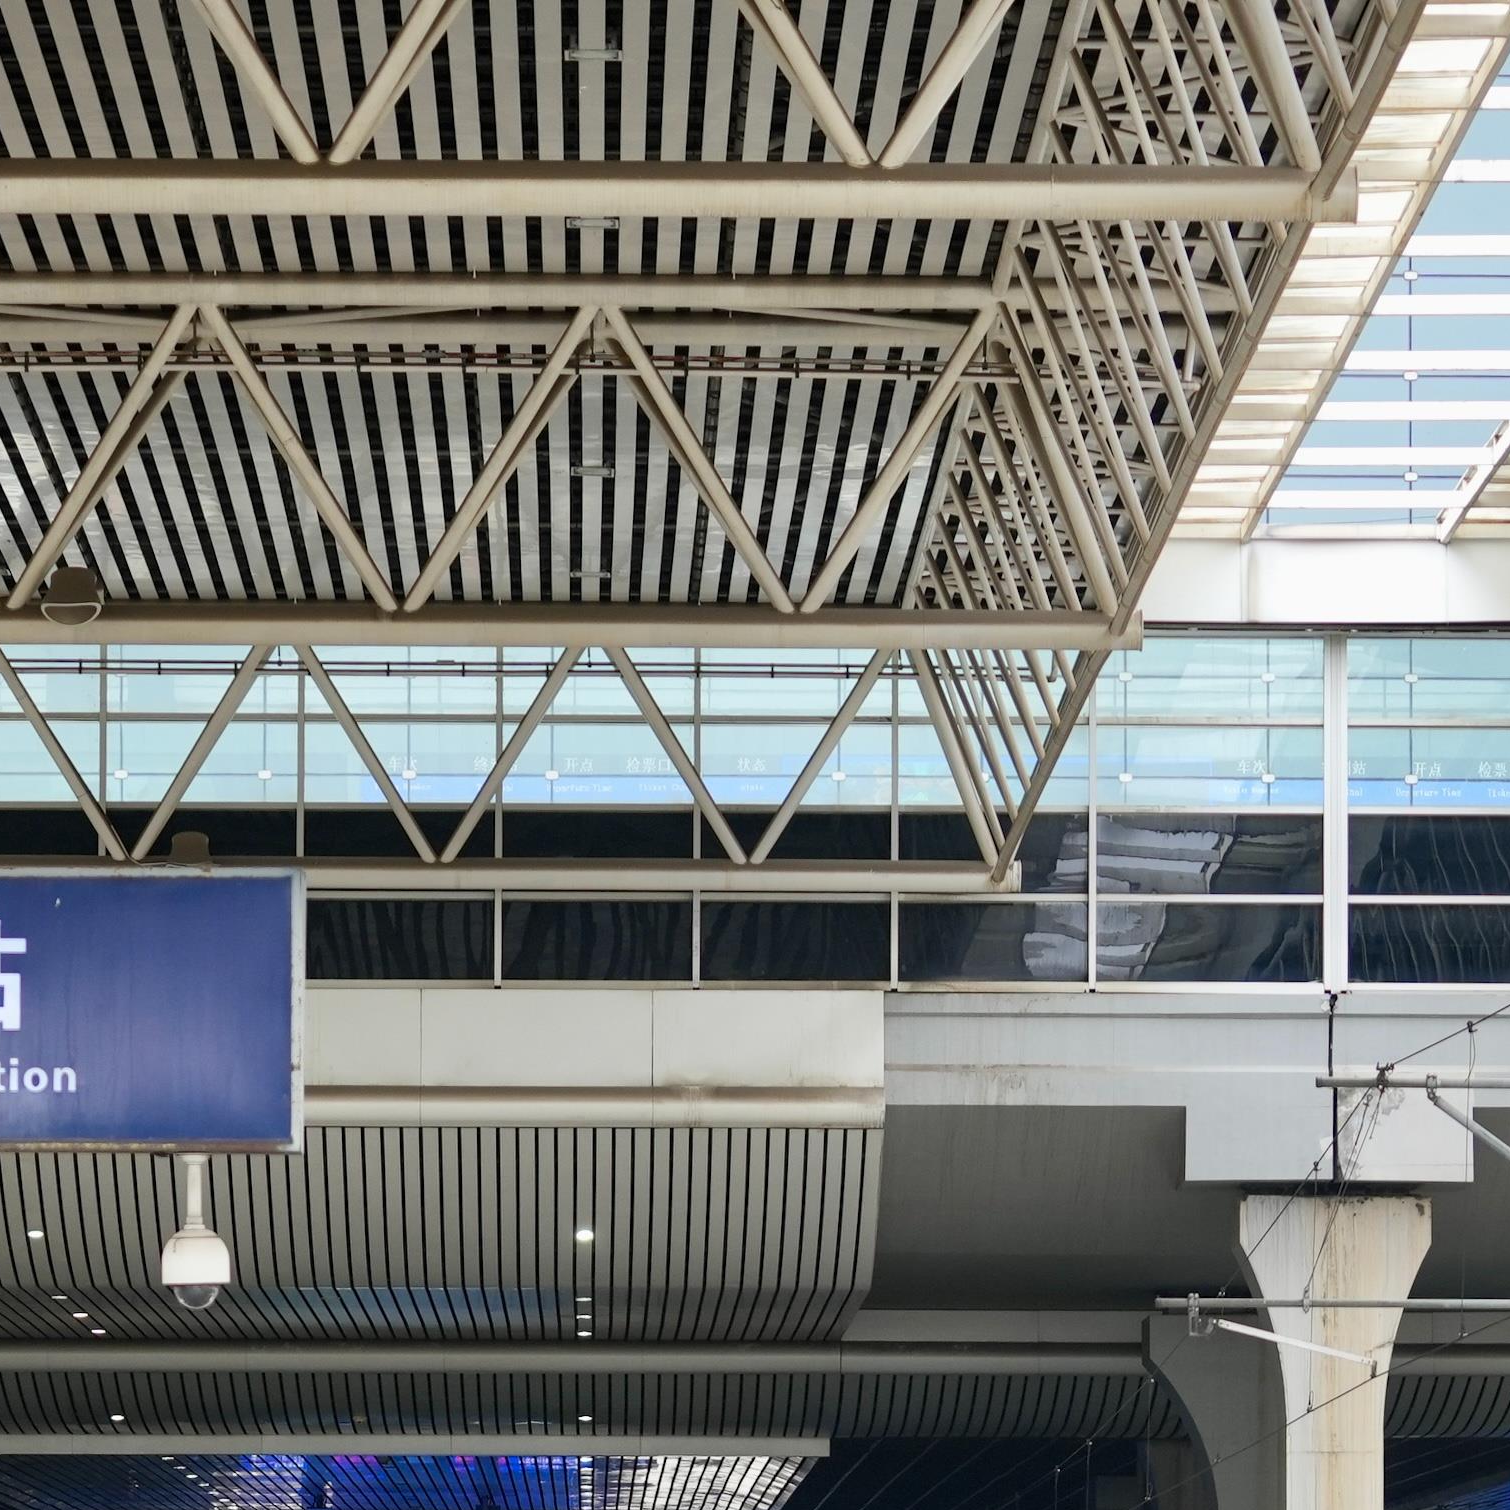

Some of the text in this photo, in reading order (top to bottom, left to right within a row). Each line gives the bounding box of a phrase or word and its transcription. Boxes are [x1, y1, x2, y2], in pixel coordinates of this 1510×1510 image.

[564, 757, 594, 772] 开点
[737, 757, 766, 772] 状态
[1237, 759, 1266, 774] 车次
[1413, 761, 1442, 776] 开点
